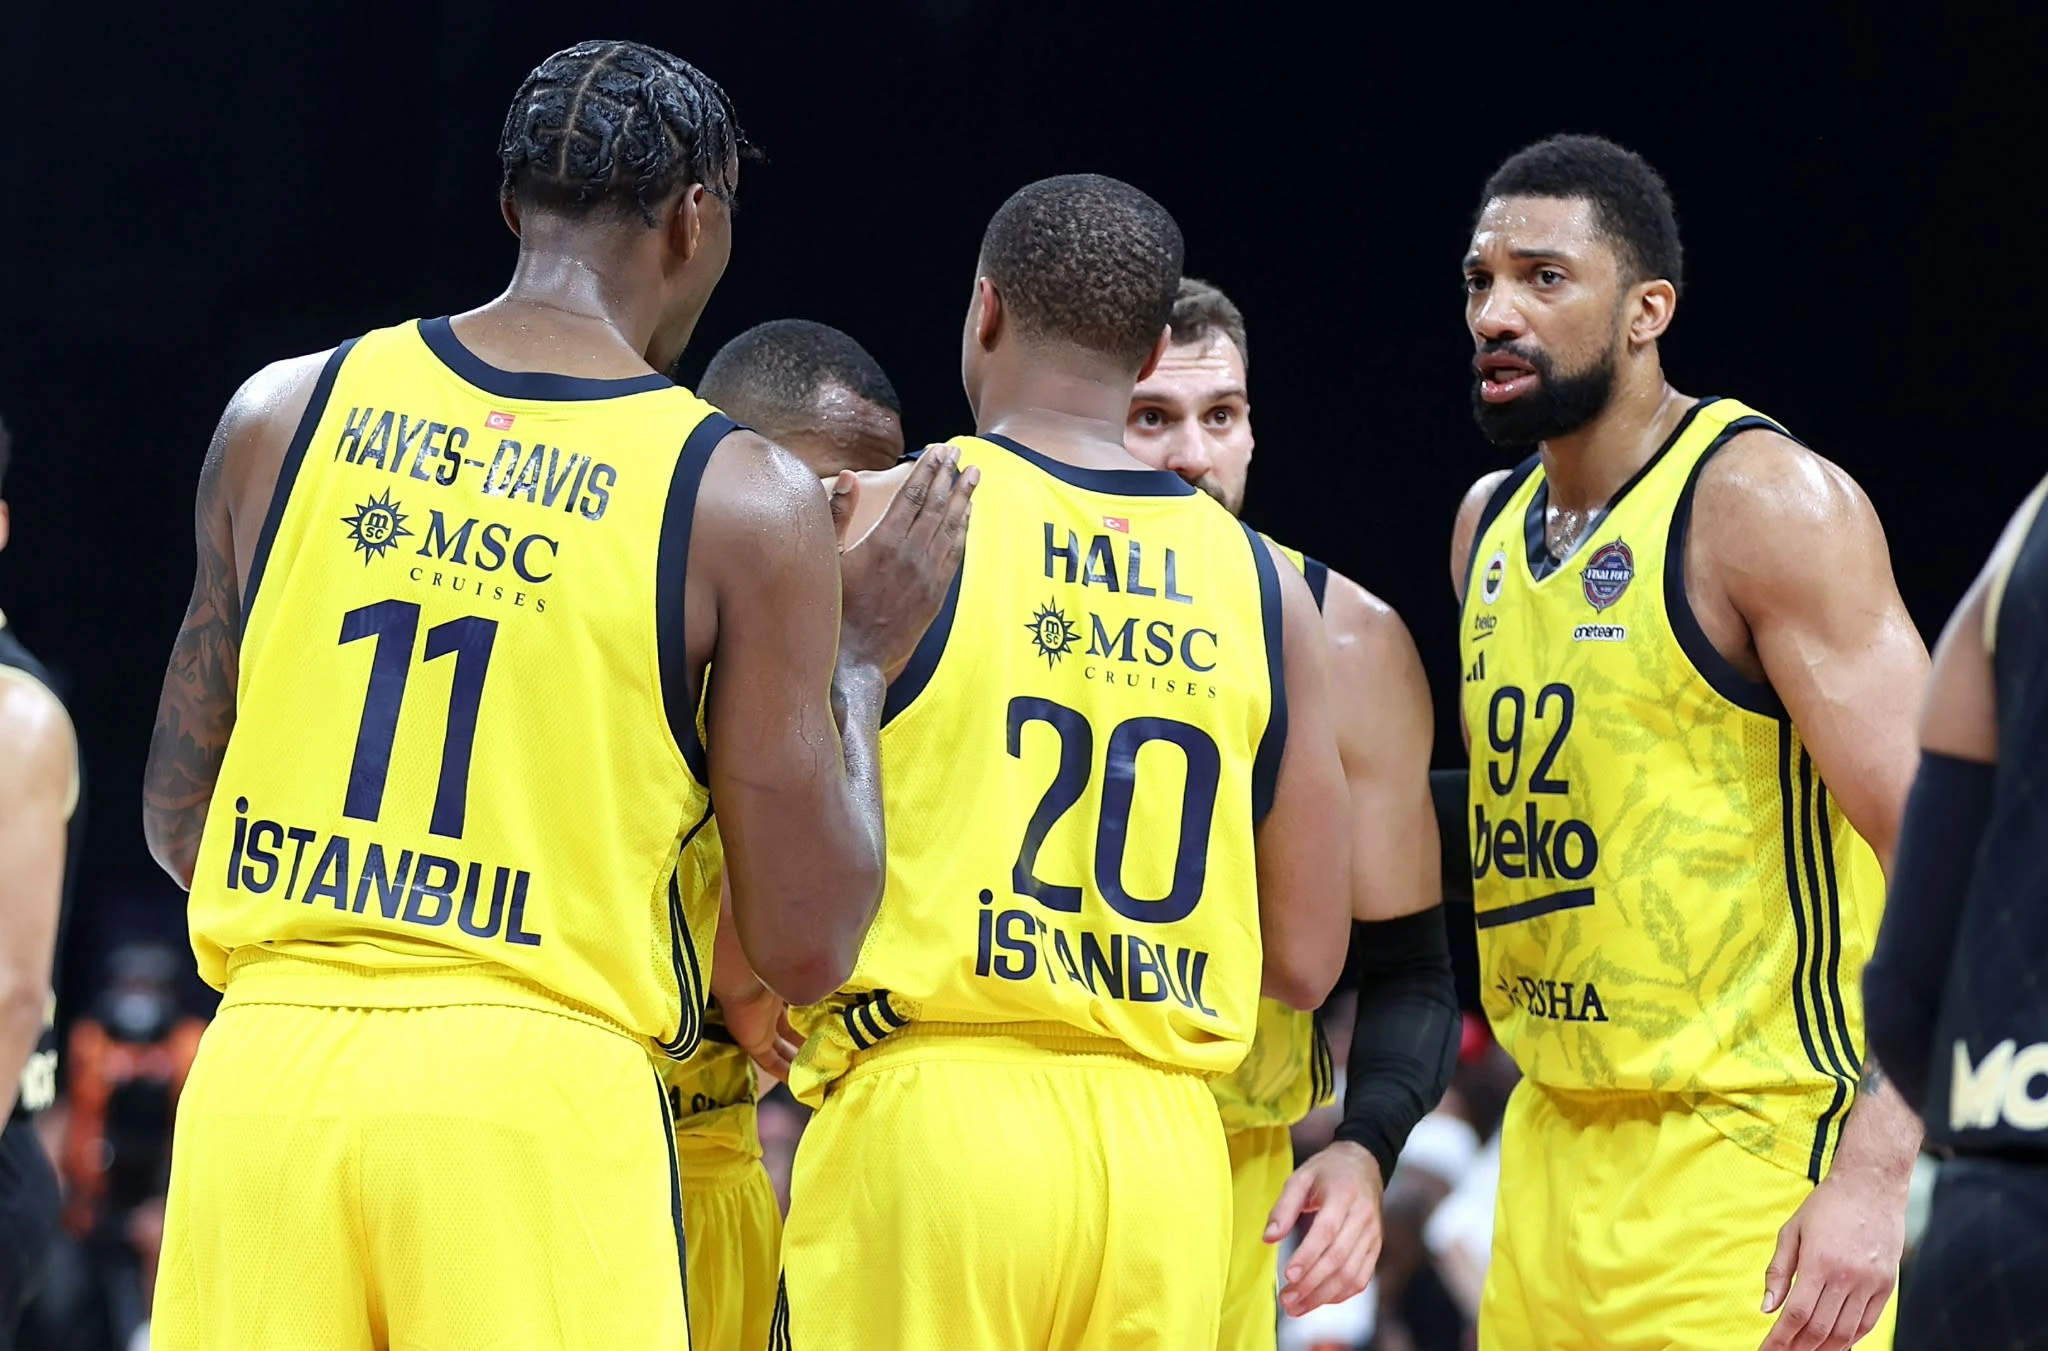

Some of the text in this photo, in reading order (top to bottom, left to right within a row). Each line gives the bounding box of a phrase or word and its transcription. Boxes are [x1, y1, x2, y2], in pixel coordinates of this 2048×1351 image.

[335, 406, 617, 522] HAYES-DAVIS
[416, 508, 559, 583] MSC
[1042, 521, 1194, 605] HALL
[409, 566, 547, 613] CRUISES
[1085, 611, 1218, 673] MSC
[1574, 625, 1625, 639] oneteam
[337, 598, 500, 840] 11
[1085, 666, 1218, 699] CRUISES
[1487, 683, 1575, 797] 92
[1006, 695, 1221, 924] 20
[1473, 801, 1599, 881] beko
